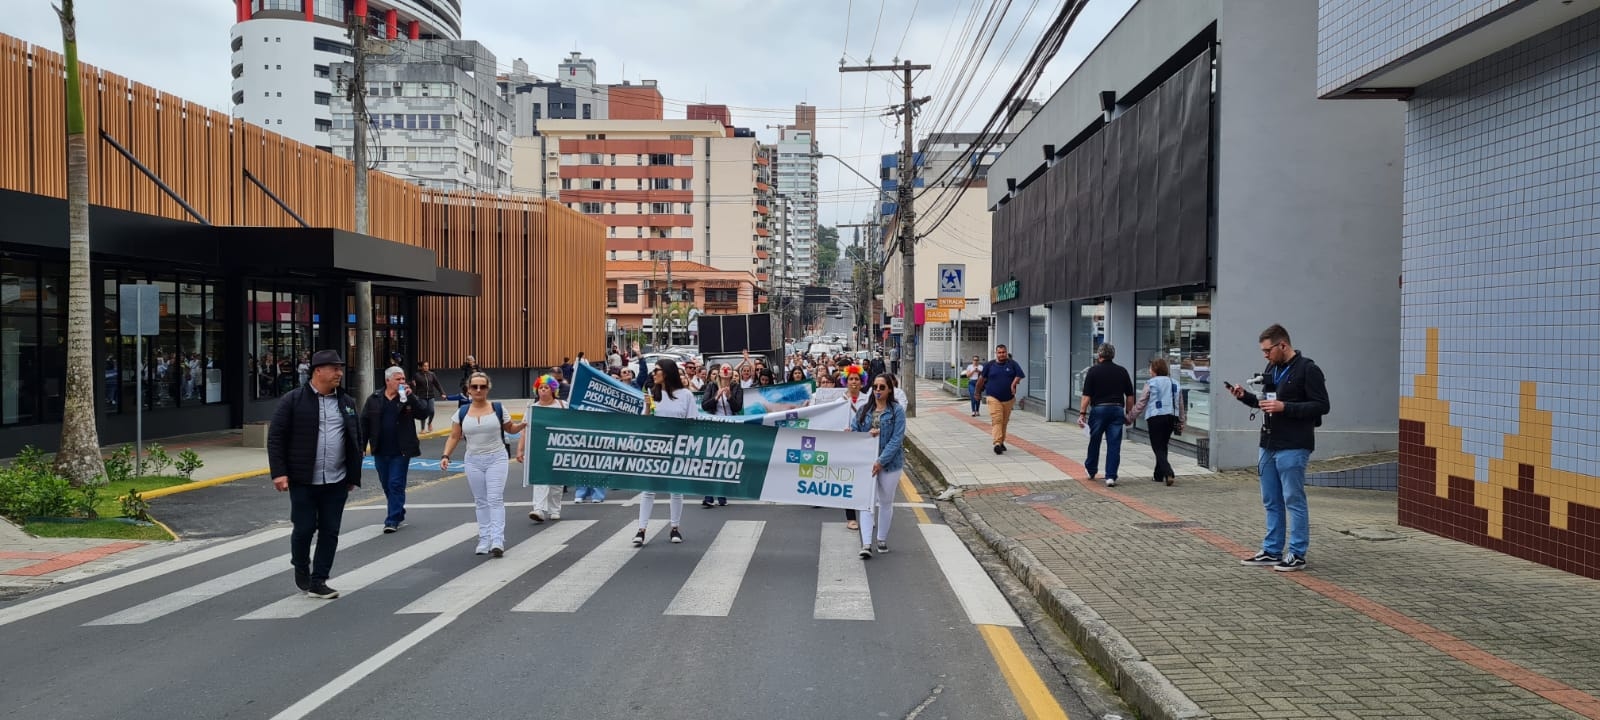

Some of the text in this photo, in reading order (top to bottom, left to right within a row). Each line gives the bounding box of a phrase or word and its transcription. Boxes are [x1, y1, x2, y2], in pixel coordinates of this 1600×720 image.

[584, 391, 603, 402] PISO
[604, 396, 640, 415] SALARIAL
[587, 380, 620, 398] PATRÕES
[625, 395, 638, 404] STF
[547, 432, 746, 459] NOSSA LUTA NÃO SERÁ EM VÃO.
[552, 453, 744, 479] DEVOLVAM NOSSO DIREITO!
[814, 466, 855, 482] SINDI
[797, 480, 853, 498] SAÚDE
